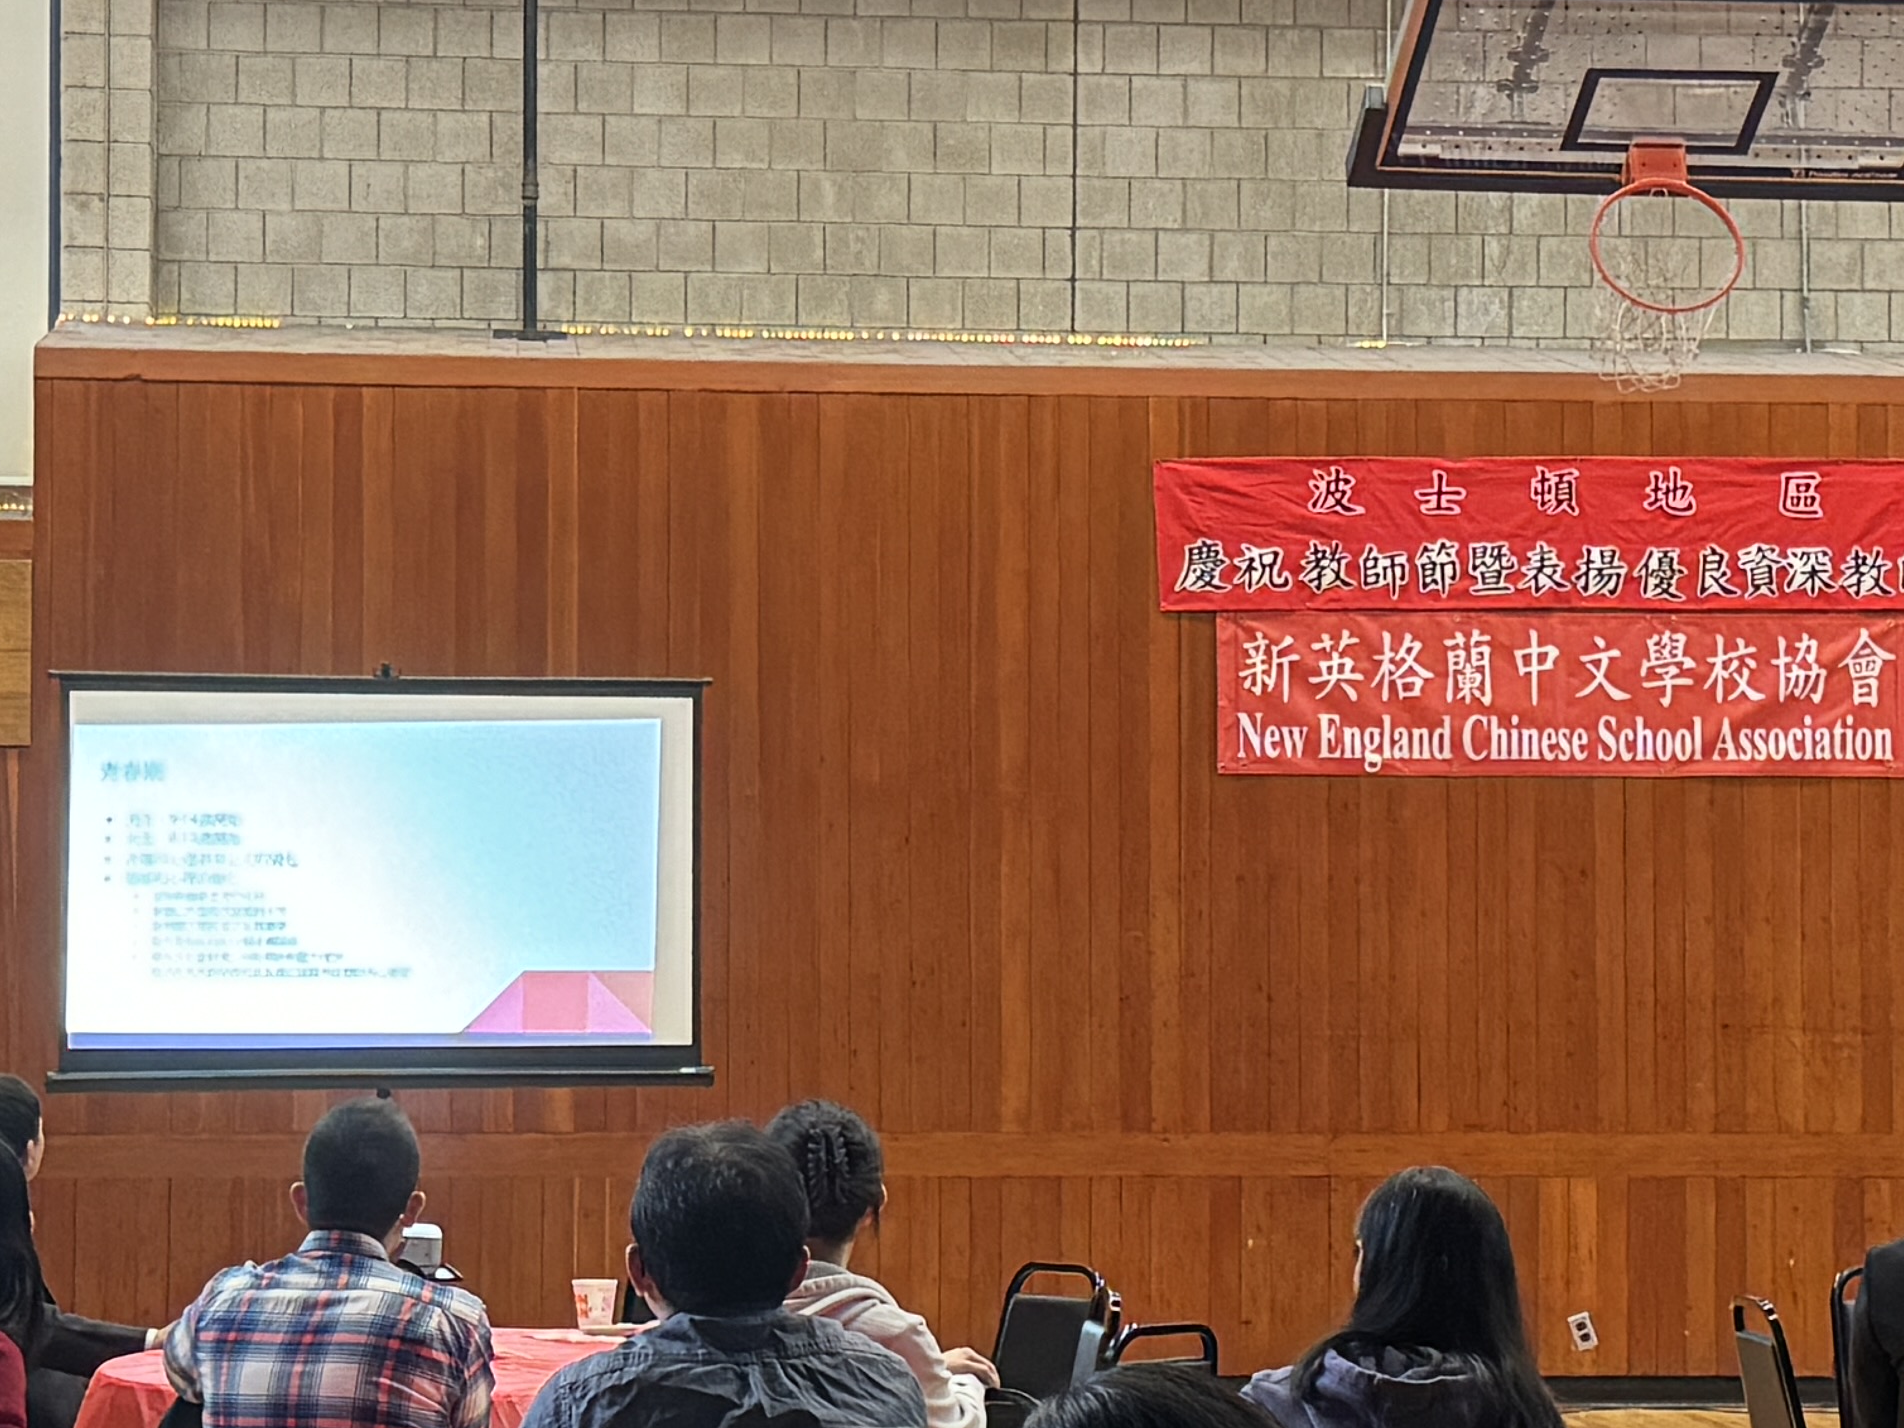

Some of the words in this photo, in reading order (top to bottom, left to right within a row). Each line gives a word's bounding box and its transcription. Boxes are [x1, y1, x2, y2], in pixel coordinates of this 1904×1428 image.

[1308, 466, 1824, 518] 波士頓地區
[1237, 628, 1898, 707] 新英格蘭中文學校協會
[1237, 713, 1308, 760] New
[1318, 713, 1452, 772] England
[1462, 714, 1588, 762] Chinese
[1597, 714, 1703, 762] School
[1711, 714, 1893, 762] Association
